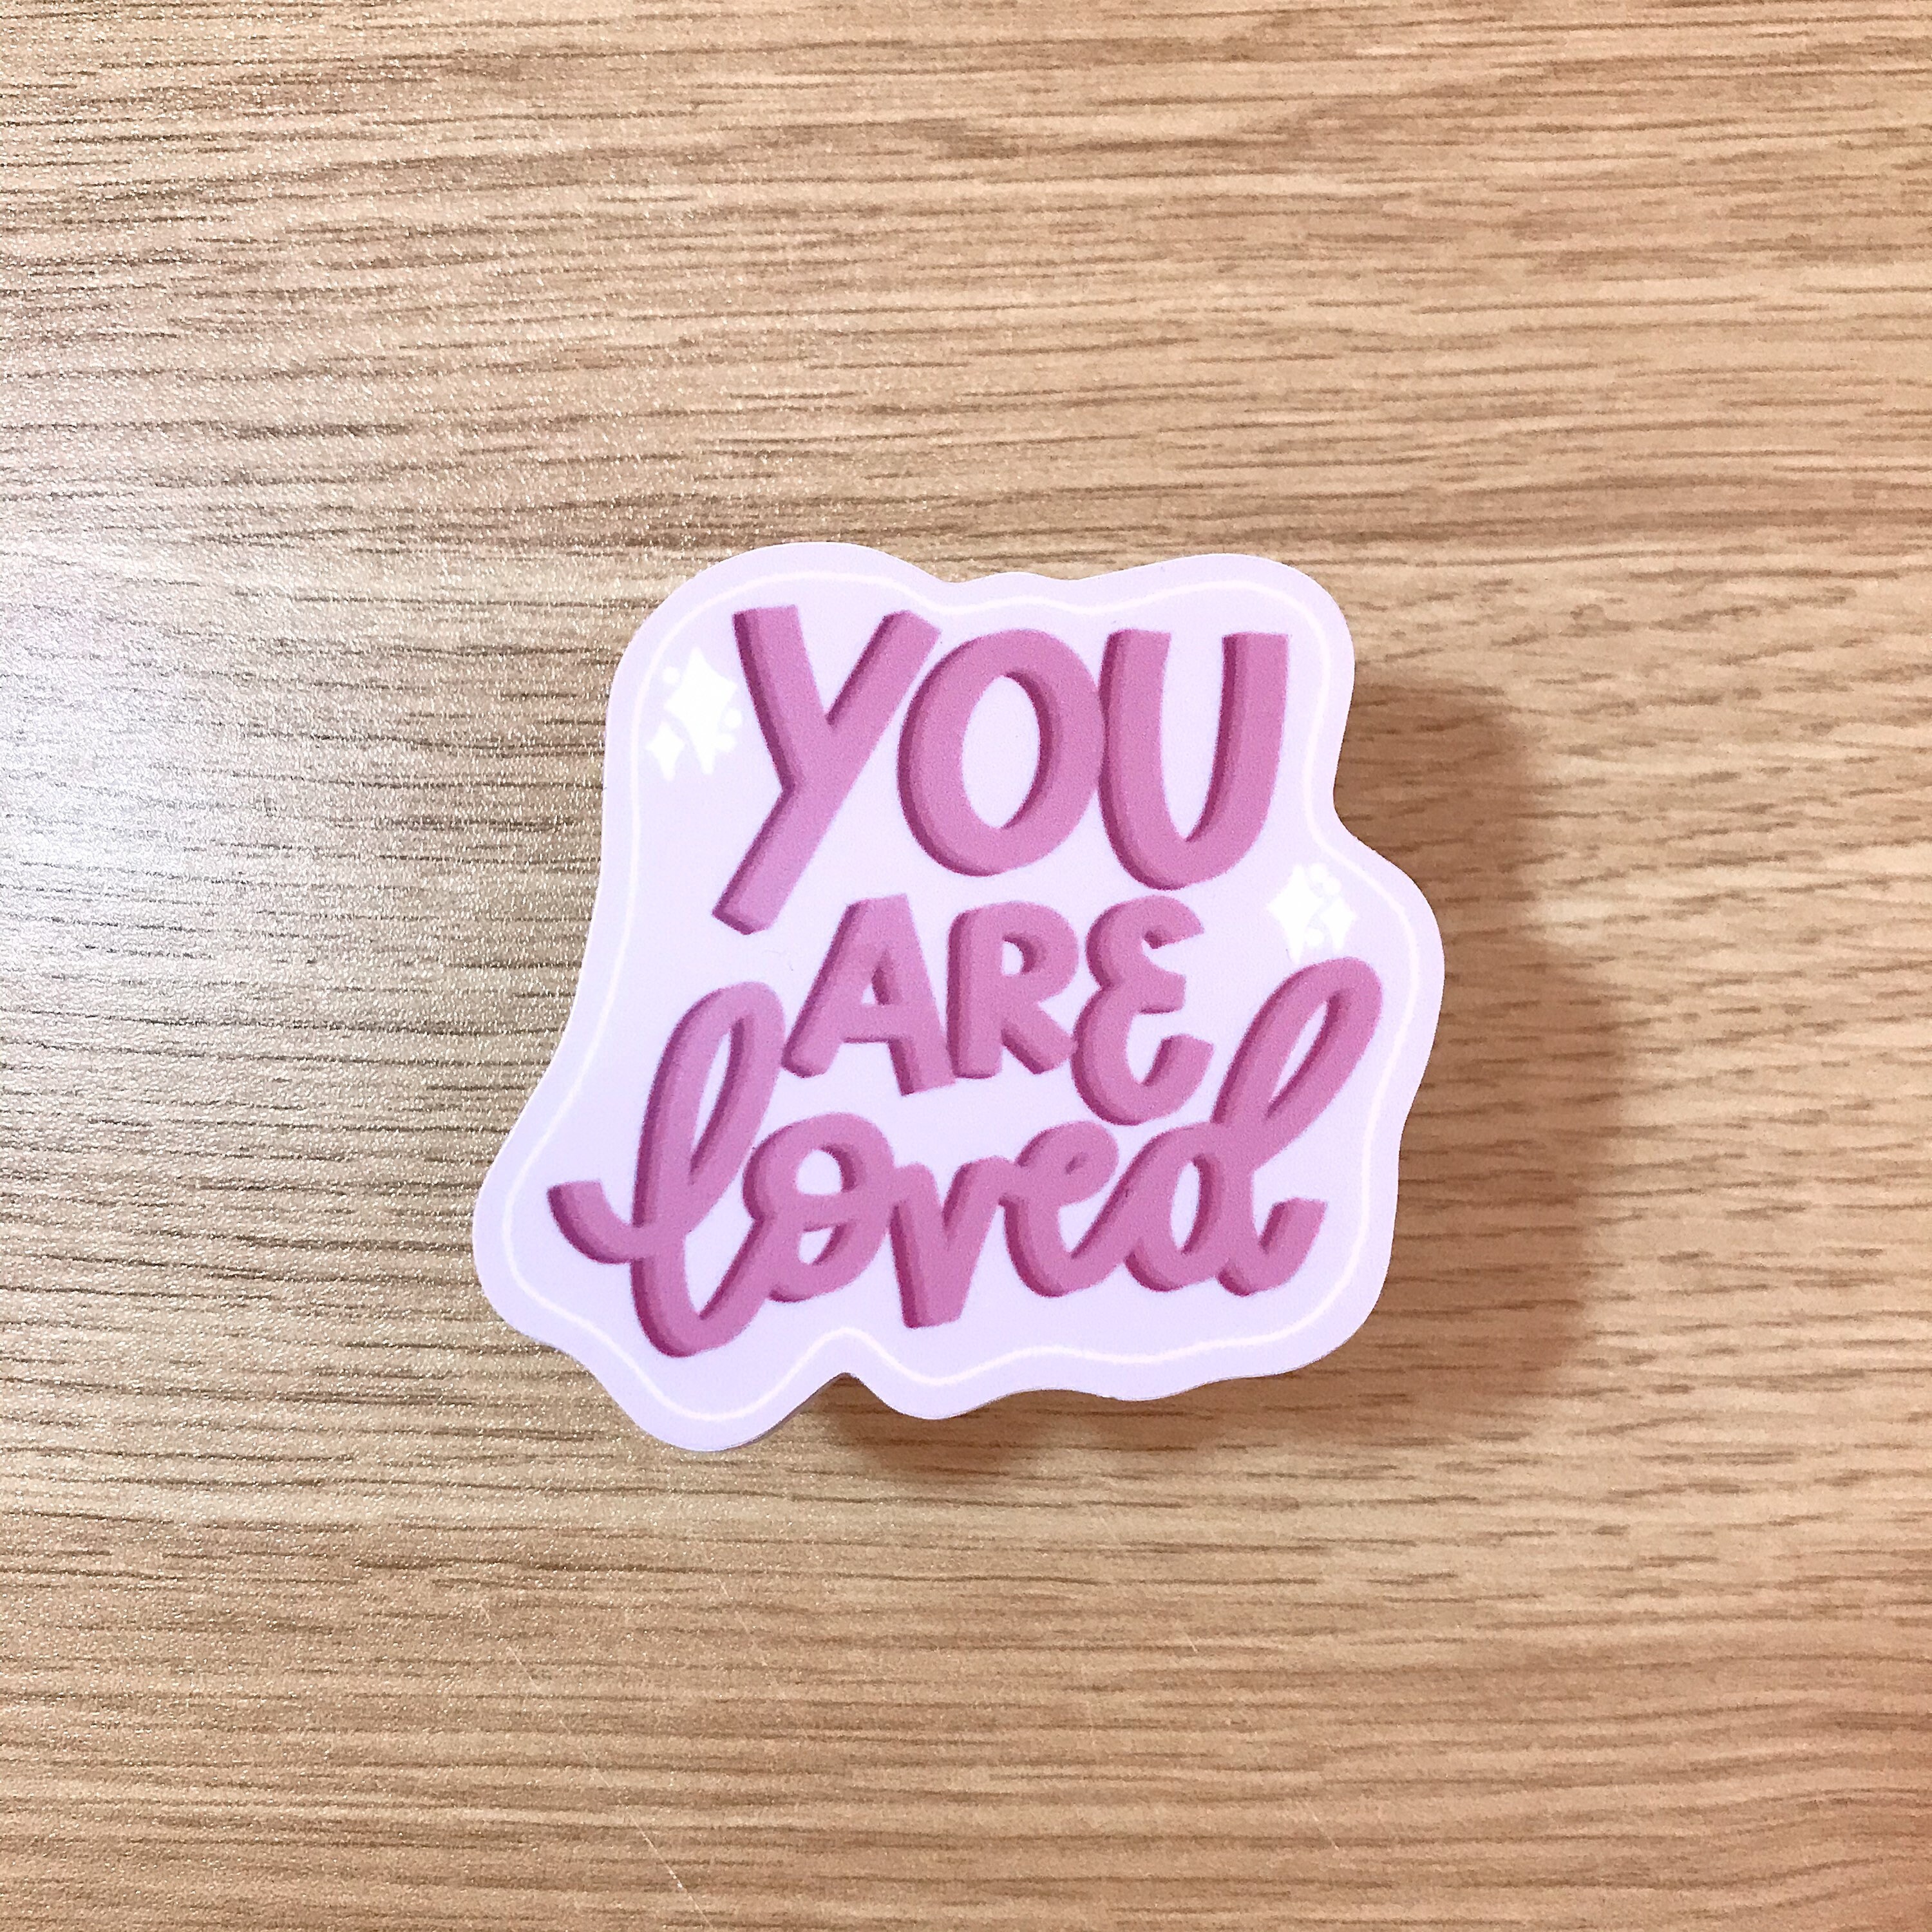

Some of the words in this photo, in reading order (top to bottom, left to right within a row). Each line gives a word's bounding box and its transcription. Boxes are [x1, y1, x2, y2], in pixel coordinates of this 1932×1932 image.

[712, 605, 1289, 936] YOU
[547, 956, 1384, 1359] loved
[781, 894, 1215, 1126] ARE
